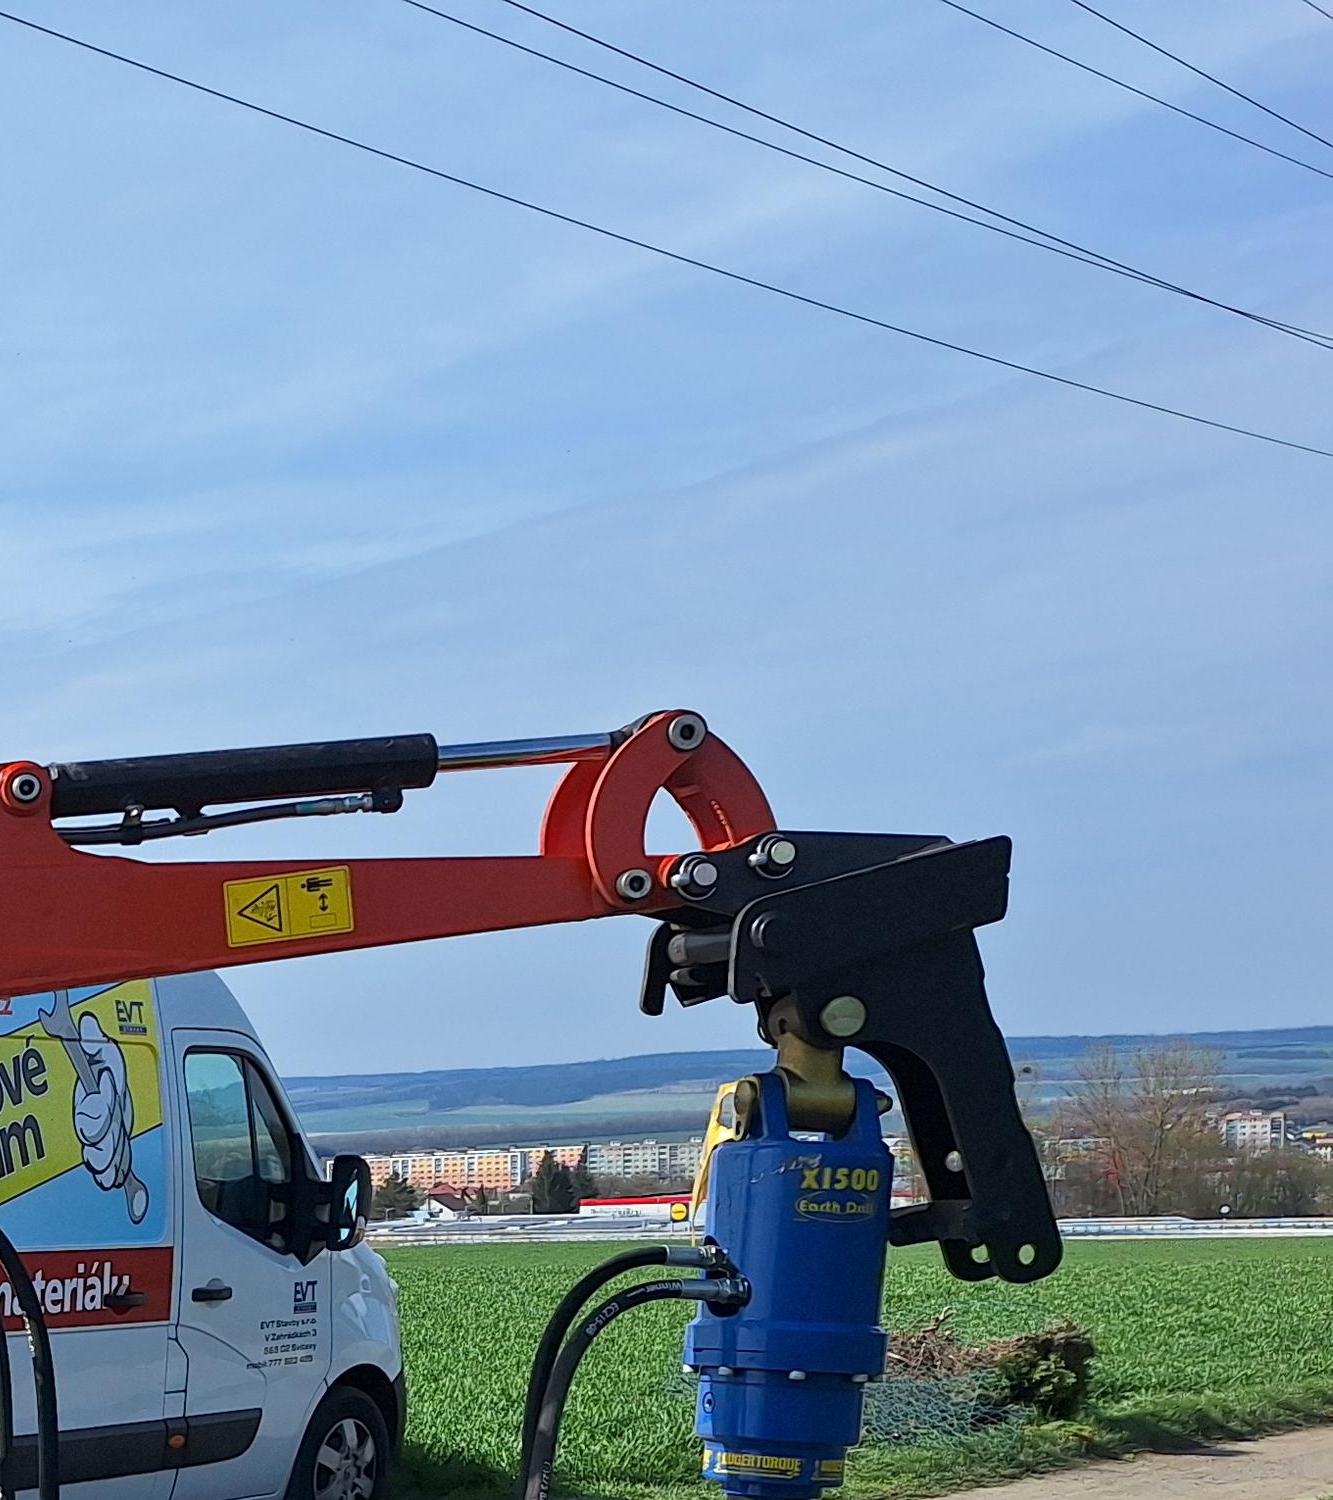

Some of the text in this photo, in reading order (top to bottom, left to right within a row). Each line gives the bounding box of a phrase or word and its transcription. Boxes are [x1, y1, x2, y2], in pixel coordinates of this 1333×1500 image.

[115, 1000, 144, 1024] EVT
[800, 1167, 880, 1192] X1500
[799, 1199, 841, 1214] Earth
[293, 1280, 318, 1302] EVT
